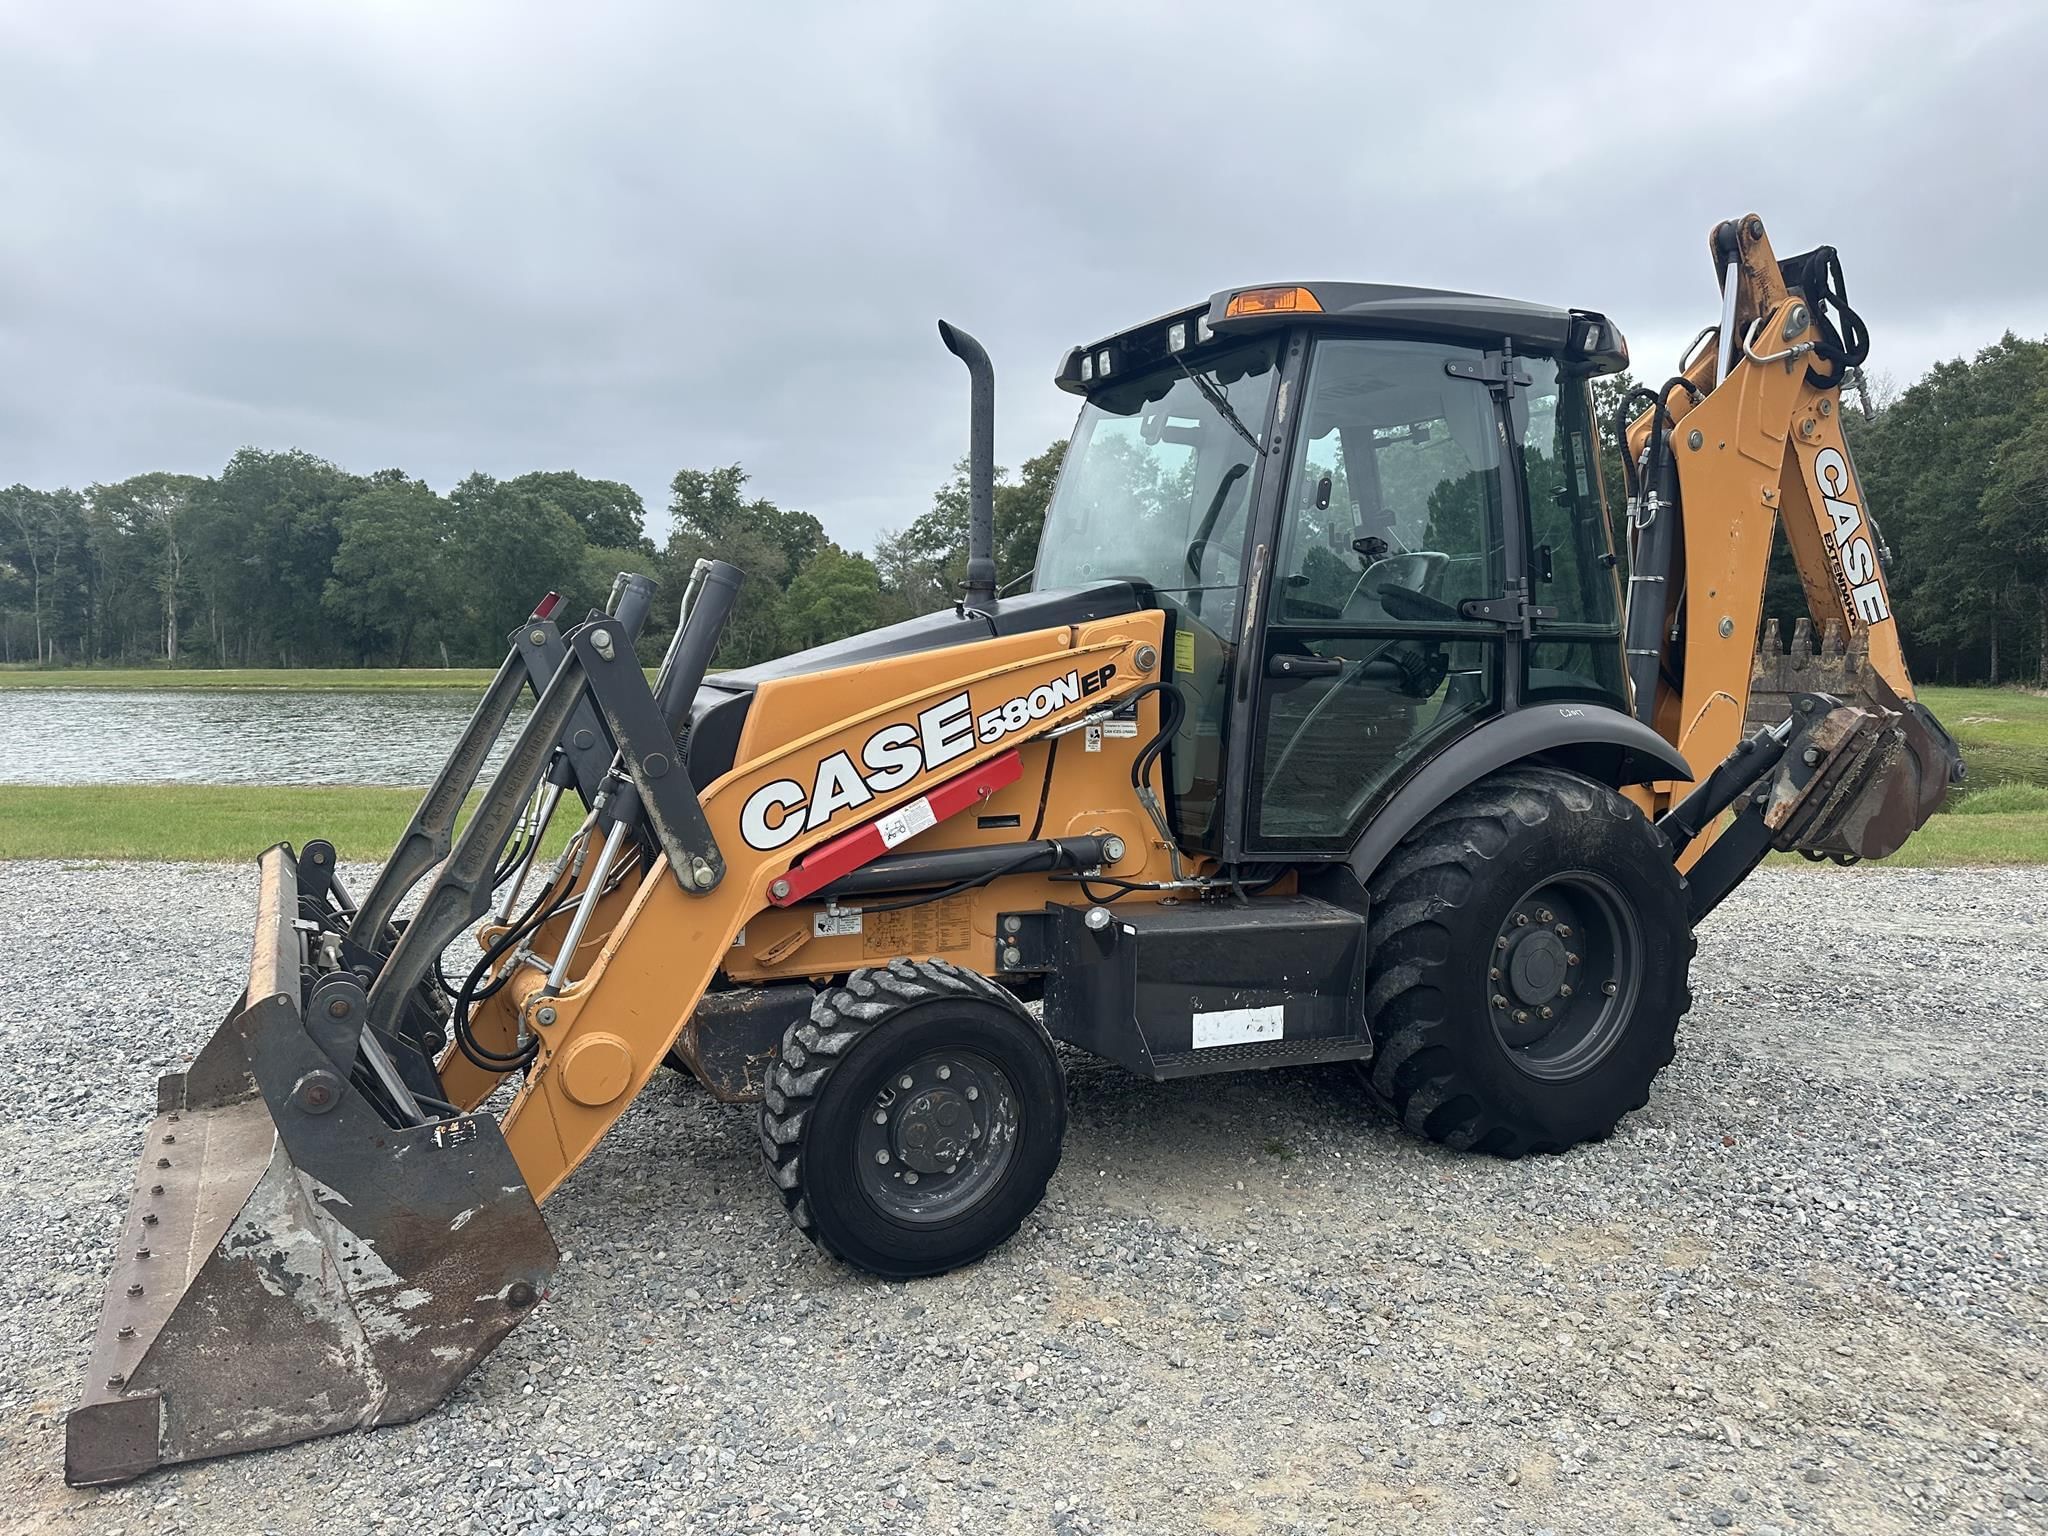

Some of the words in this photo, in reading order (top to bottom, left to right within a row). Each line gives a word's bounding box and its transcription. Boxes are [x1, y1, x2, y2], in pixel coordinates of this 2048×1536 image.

[1814, 447, 1889, 626] CASE
[1824, 532, 1858, 627] EXTENDAHO
[740, 690, 976, 851] CASE
[977, 669, 1081, 744] 580N
[1081, 663, 1117, 697] EP
